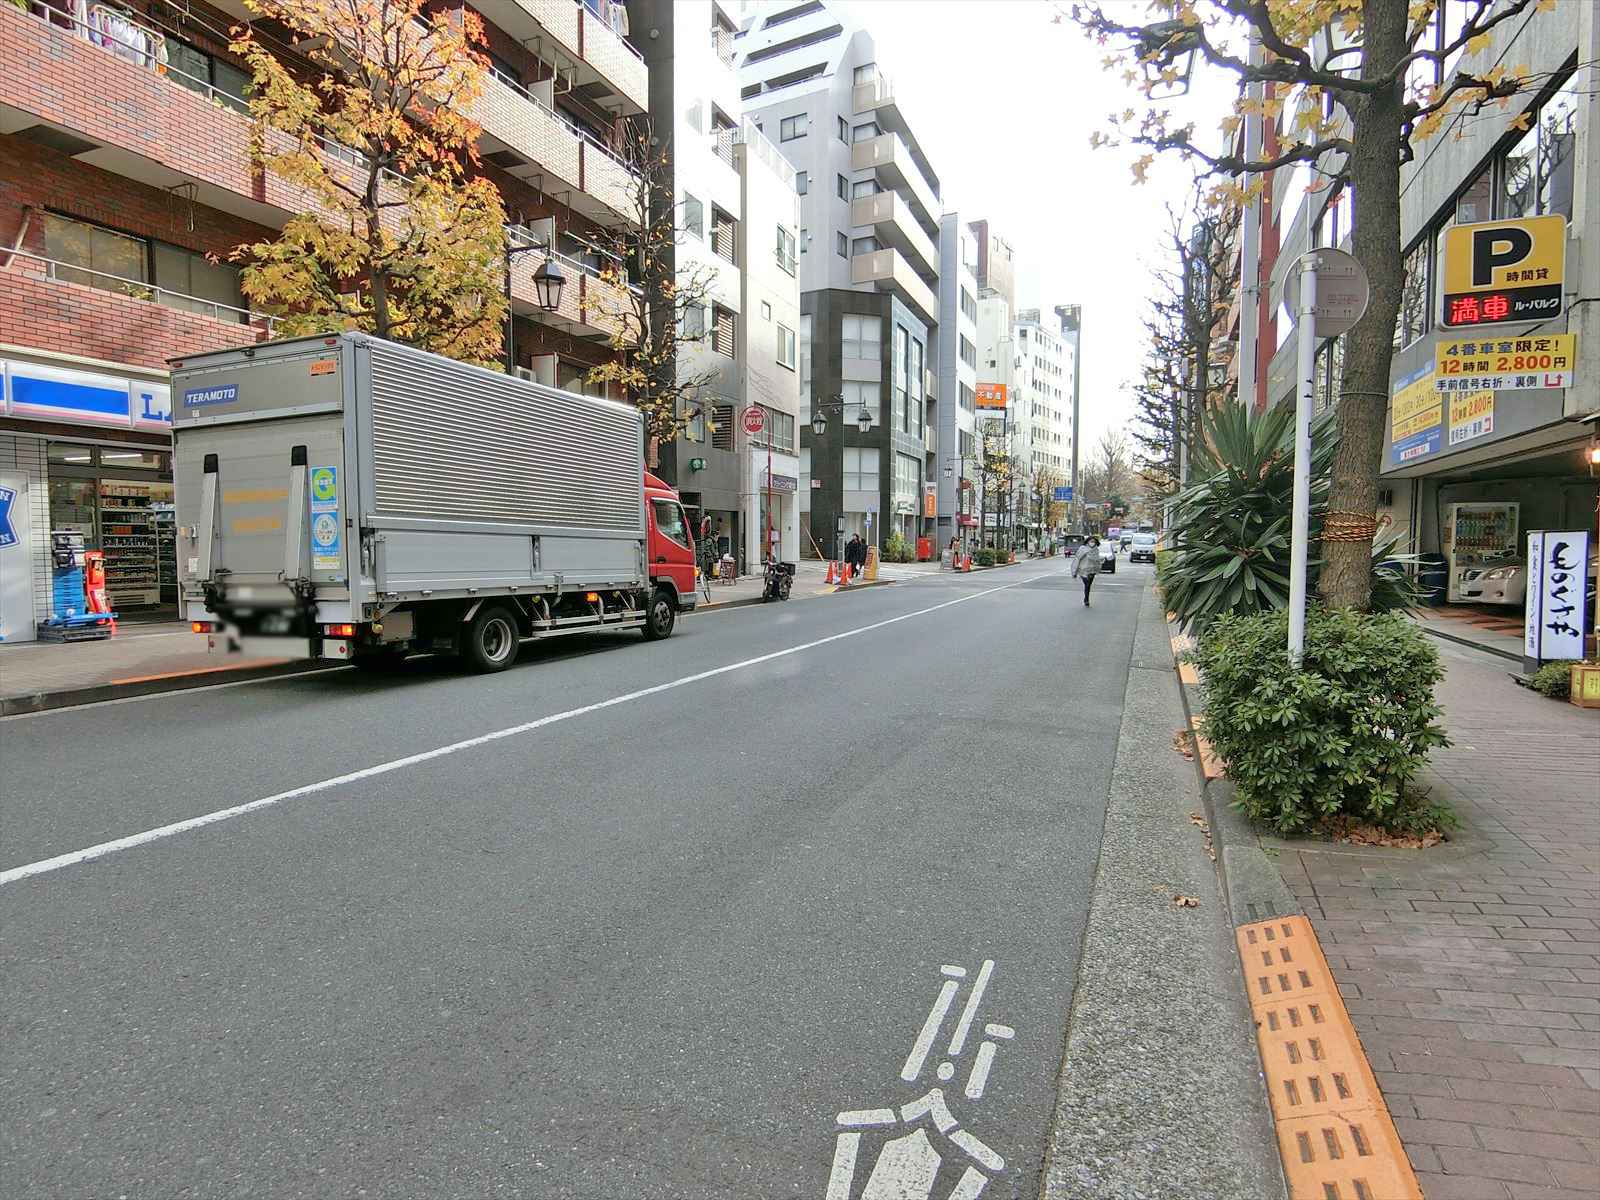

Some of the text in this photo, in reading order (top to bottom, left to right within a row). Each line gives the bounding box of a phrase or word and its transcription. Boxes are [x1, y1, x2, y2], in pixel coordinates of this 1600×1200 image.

[1472, 227, 1532, 286] P
[1506, 268, 1549, 282] 時間貸
[1451, 294, 1509, 323] 満車
[1440, 354, 1567, 374] 12時間 2,800円
[1436, 375, 1538, 391] 手前信号右折・裏側
[186, 388, 235, 404] TERAMOTO
